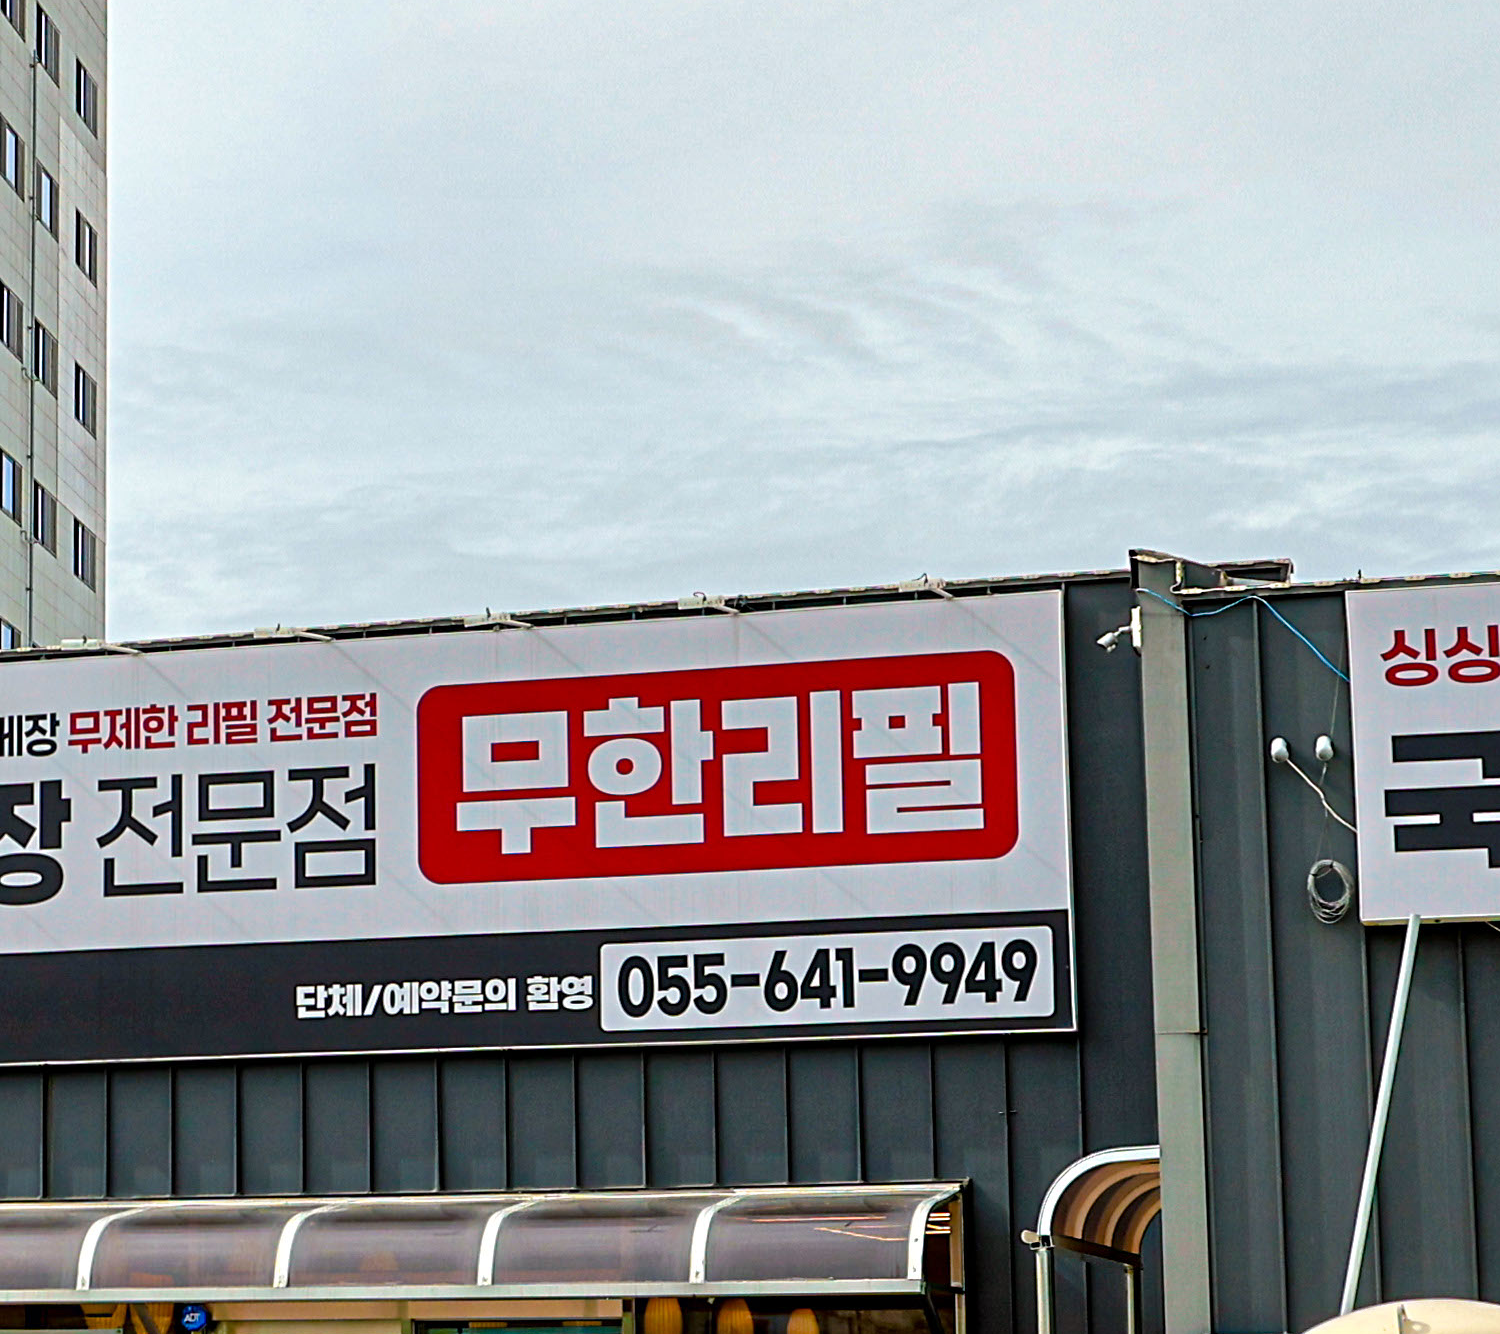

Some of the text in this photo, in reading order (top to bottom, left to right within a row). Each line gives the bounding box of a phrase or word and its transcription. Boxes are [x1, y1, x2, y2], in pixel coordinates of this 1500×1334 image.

[67, 700, 178, 755] 무제한
[185, 697, 261, 746] 리필
[266, 691, 379, 743] 전문점
[455, 680, 985, 857] 무한리필
[96, 762, 379, 898] 전문점
[295, 973, 595, 1021] 단체/예약문의 환영
[616, 938, 1038, 1018] 055-641-9949
